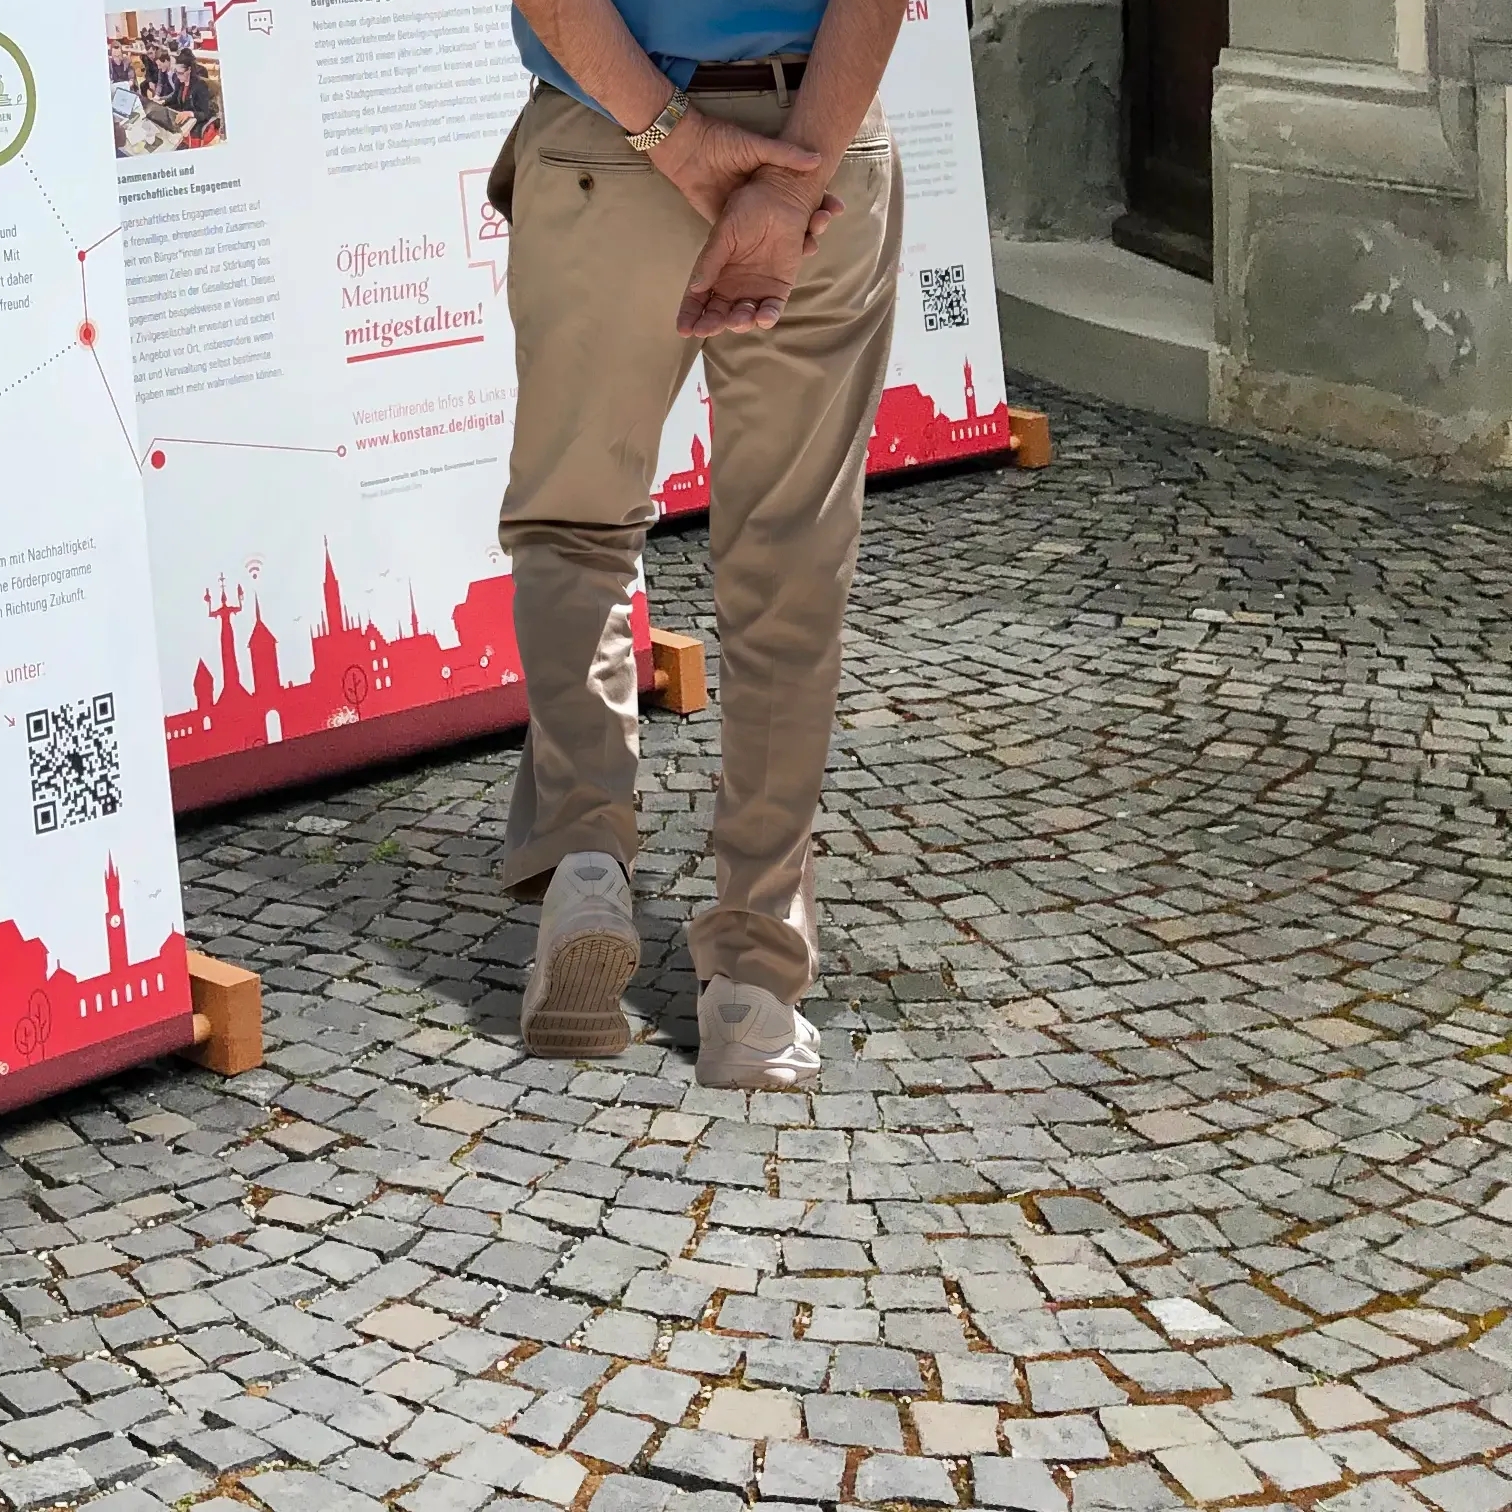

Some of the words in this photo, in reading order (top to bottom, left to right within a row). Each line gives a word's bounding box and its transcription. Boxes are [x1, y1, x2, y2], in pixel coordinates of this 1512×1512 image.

[336, 234, 446, 279] Öffentliche
[341, 277, 430, 309] Meinung
[344, 302, 483, 348] mitgestalten!
[351, 398, 435, 426] Weiterführende
[437, 393, 464, 410] Infos
[467, 389, 477, 406] &
[479, 387, 507, 404] Links
[355, 409, 505, 451] www.konstanz.de/digital
[5, 662, 45, 684] unter:
